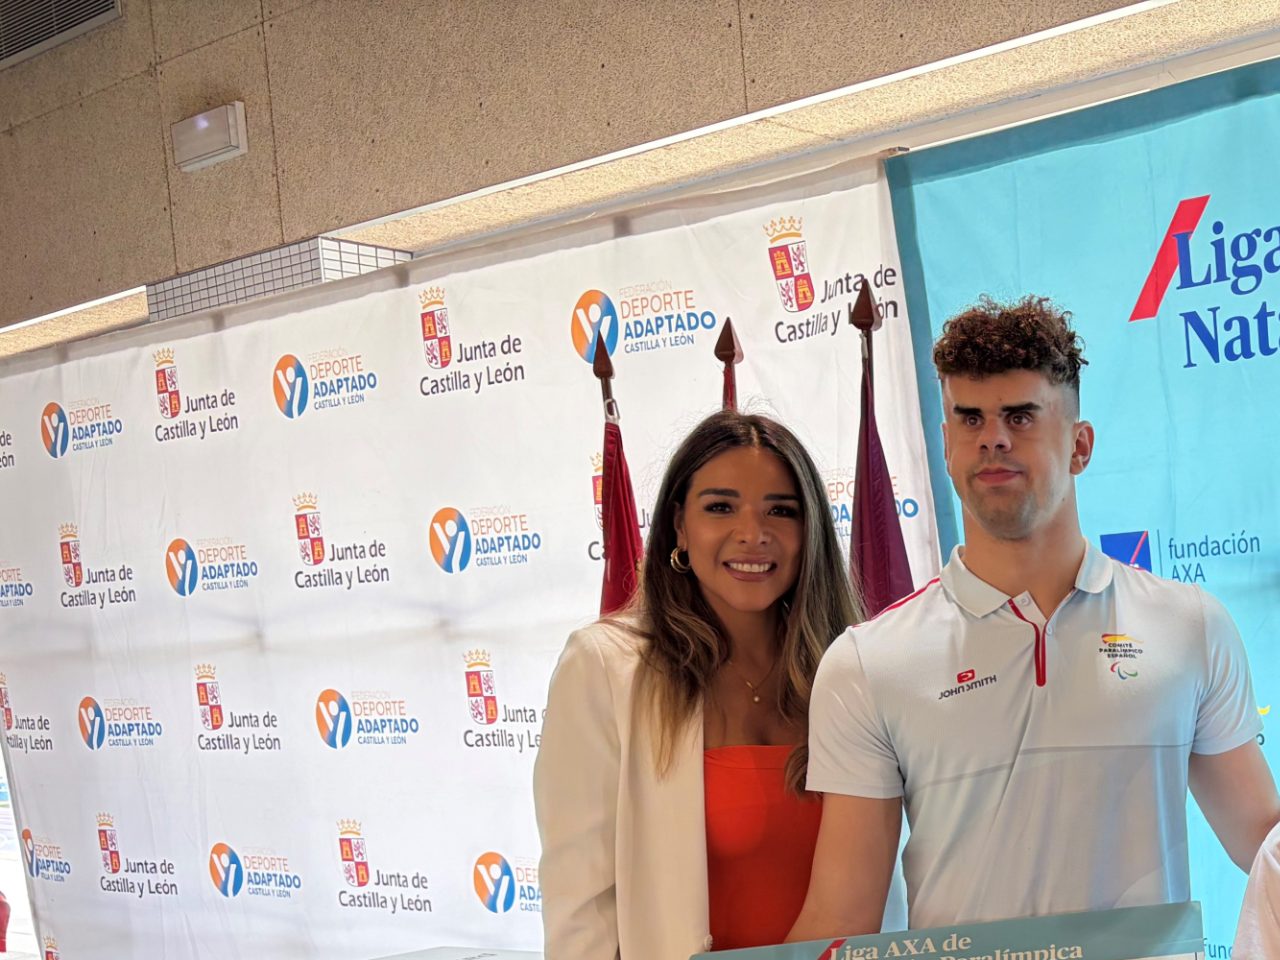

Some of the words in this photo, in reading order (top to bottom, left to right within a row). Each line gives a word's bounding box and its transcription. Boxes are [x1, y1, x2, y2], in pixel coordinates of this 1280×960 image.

[874, 264, 897, 289] de
[620, 290, 695, 319] DEPORTE
[624, 311, 716, 340] ADAPTADO
[775, 311, 828, 343] Castilla
[457, 339, 496, 363] Junta
[500, 334, 522, 355] de
[624, 339, 660, 353] CASTILLA
[669, 334, 694, 347] LEÓN
[310, 355, 364, 380] DEPORTE
[313, 372, 377, 399] ADAPTADO
[420, 370, 471, 397] Castilla
[487, 362, 525, 385] León
[184, 393, 218, 413] Junta
[216, 389, 235, 406] de
[69, 404, 112, 425] DEPORTE
[72, 419, 122, 441] ADAPTADO
[155, 421, 197, 443] Castilla
[209, 412, 239, 433] León
[471, 515, 529, 536] DEPORTE
[199, 545, 247, 563] DEPORTE
[329, 543, 366, 562] Junta
[370, 540, 386, 557] de
[475, 533, 541, 555] ADAPTADO
[1168, 530, 1260, 560] fundación
[86, 567, 116, 585] Junta
[119, 564, 133, 581] de
[201, 562, 258, 581] ADAPTADO
[294, 568, 343, 589] Castilla
[357, 564, 389, 584] León
[1172, 563, 1206, 583] AXA
[60, 590, 96, 608] Castilla
[108, 586, 136, 604] León
[105, 706, 152, 721] DEPORTE
[353, 701, 406, 716] DEPORTE
[502, 704, 536, 724] Junta
[108, 722, 162, 737] ADAPTADO
[228, 712, 260, 728] Junta
[263, 712, 277, 728] de
[357, 718, 419, 734] ADAPTADO
[198, 734, 241, 751] Castilla
[254, 733, 281, 751] León
[464, 730, 514, 748] Castilla
[124, 858, 157, 874] Junta
[160, 859, 174, 875] de
[244, 856, 289, 872] DEPORTE
[100, 876, 135, 894] Castilla
[148, 879, 178, 895] León
[247, 873, 301, 889] ADAPTADO
[374, 869, 409, 888] Junta
[412, 871, 428, 889] de
[338, 890, 387, 909] Castilla
[401, 894, 432, 913] León
[885, 938, 937, 958] AXA
[942, 933, 972, 951] de
